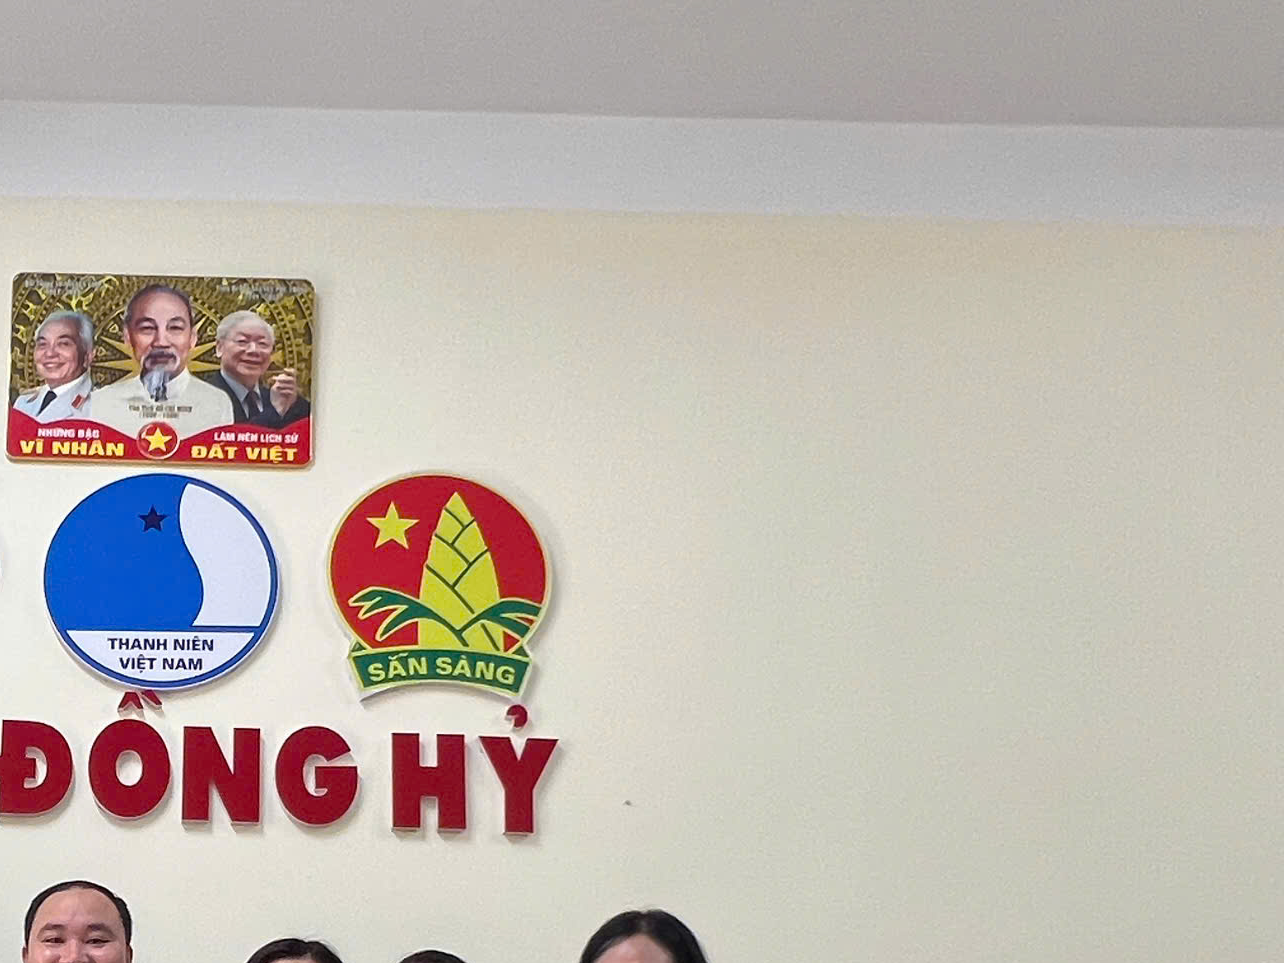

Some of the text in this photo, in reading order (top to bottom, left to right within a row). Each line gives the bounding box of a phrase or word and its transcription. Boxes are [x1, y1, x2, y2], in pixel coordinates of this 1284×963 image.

[52, 440, 124, 456] NHÂN
[191, 442, 298, 463] ĐẤT VIỆT
[107, 636, 214, 651] THANH NIÊN
[119, 654, 203, 673] VIỆT NAM
[435, 655, 516, 685] SÀNG
[391, 703, 559, 834] HỶ
